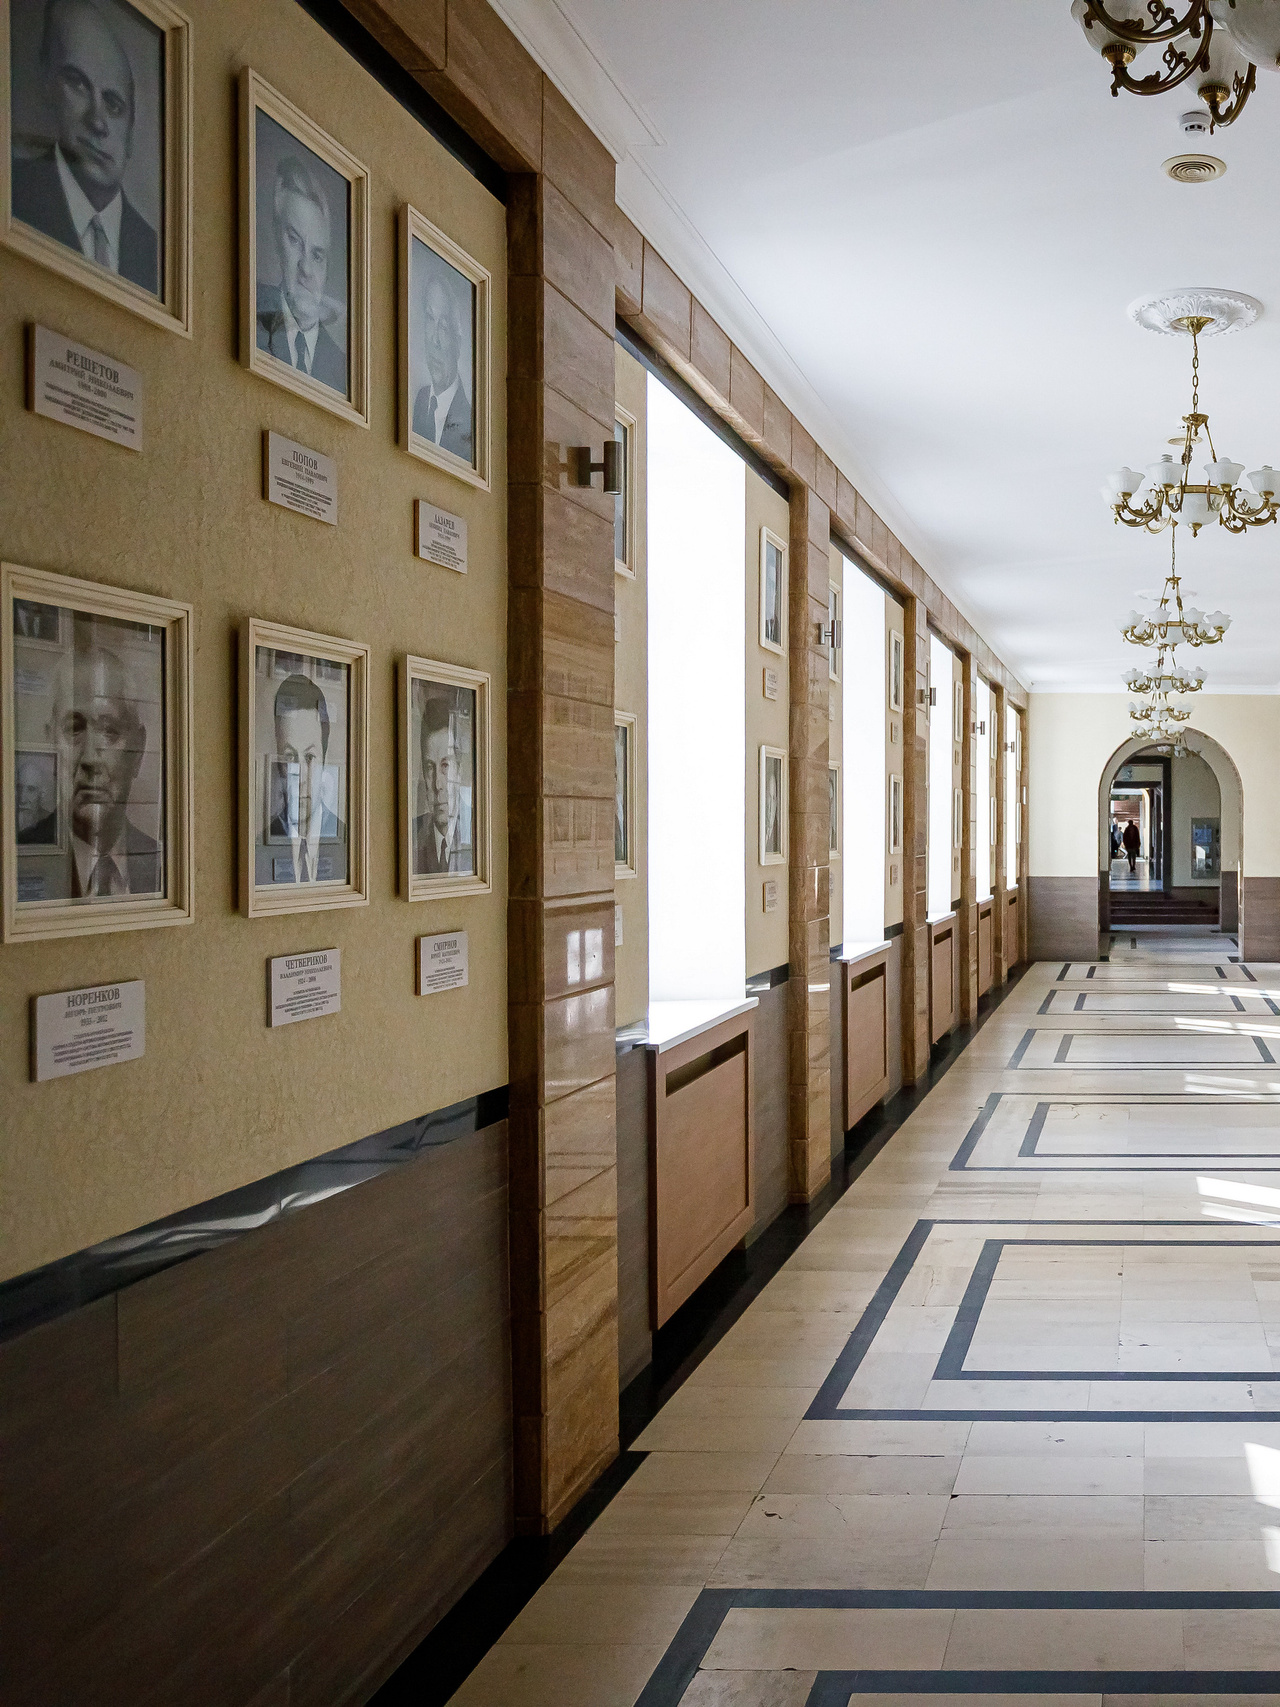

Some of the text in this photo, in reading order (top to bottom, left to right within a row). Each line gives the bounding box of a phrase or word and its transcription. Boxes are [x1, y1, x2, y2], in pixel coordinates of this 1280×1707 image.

[66, 349, 119, 384] РЕШЕТОВ
[292, 450, 318, 470] ПОПОВ
[285, 954, 328, 970] ЧЕТВЕРИКОВ
[67, 988, 120, 1008] НОРЕНКОВ
